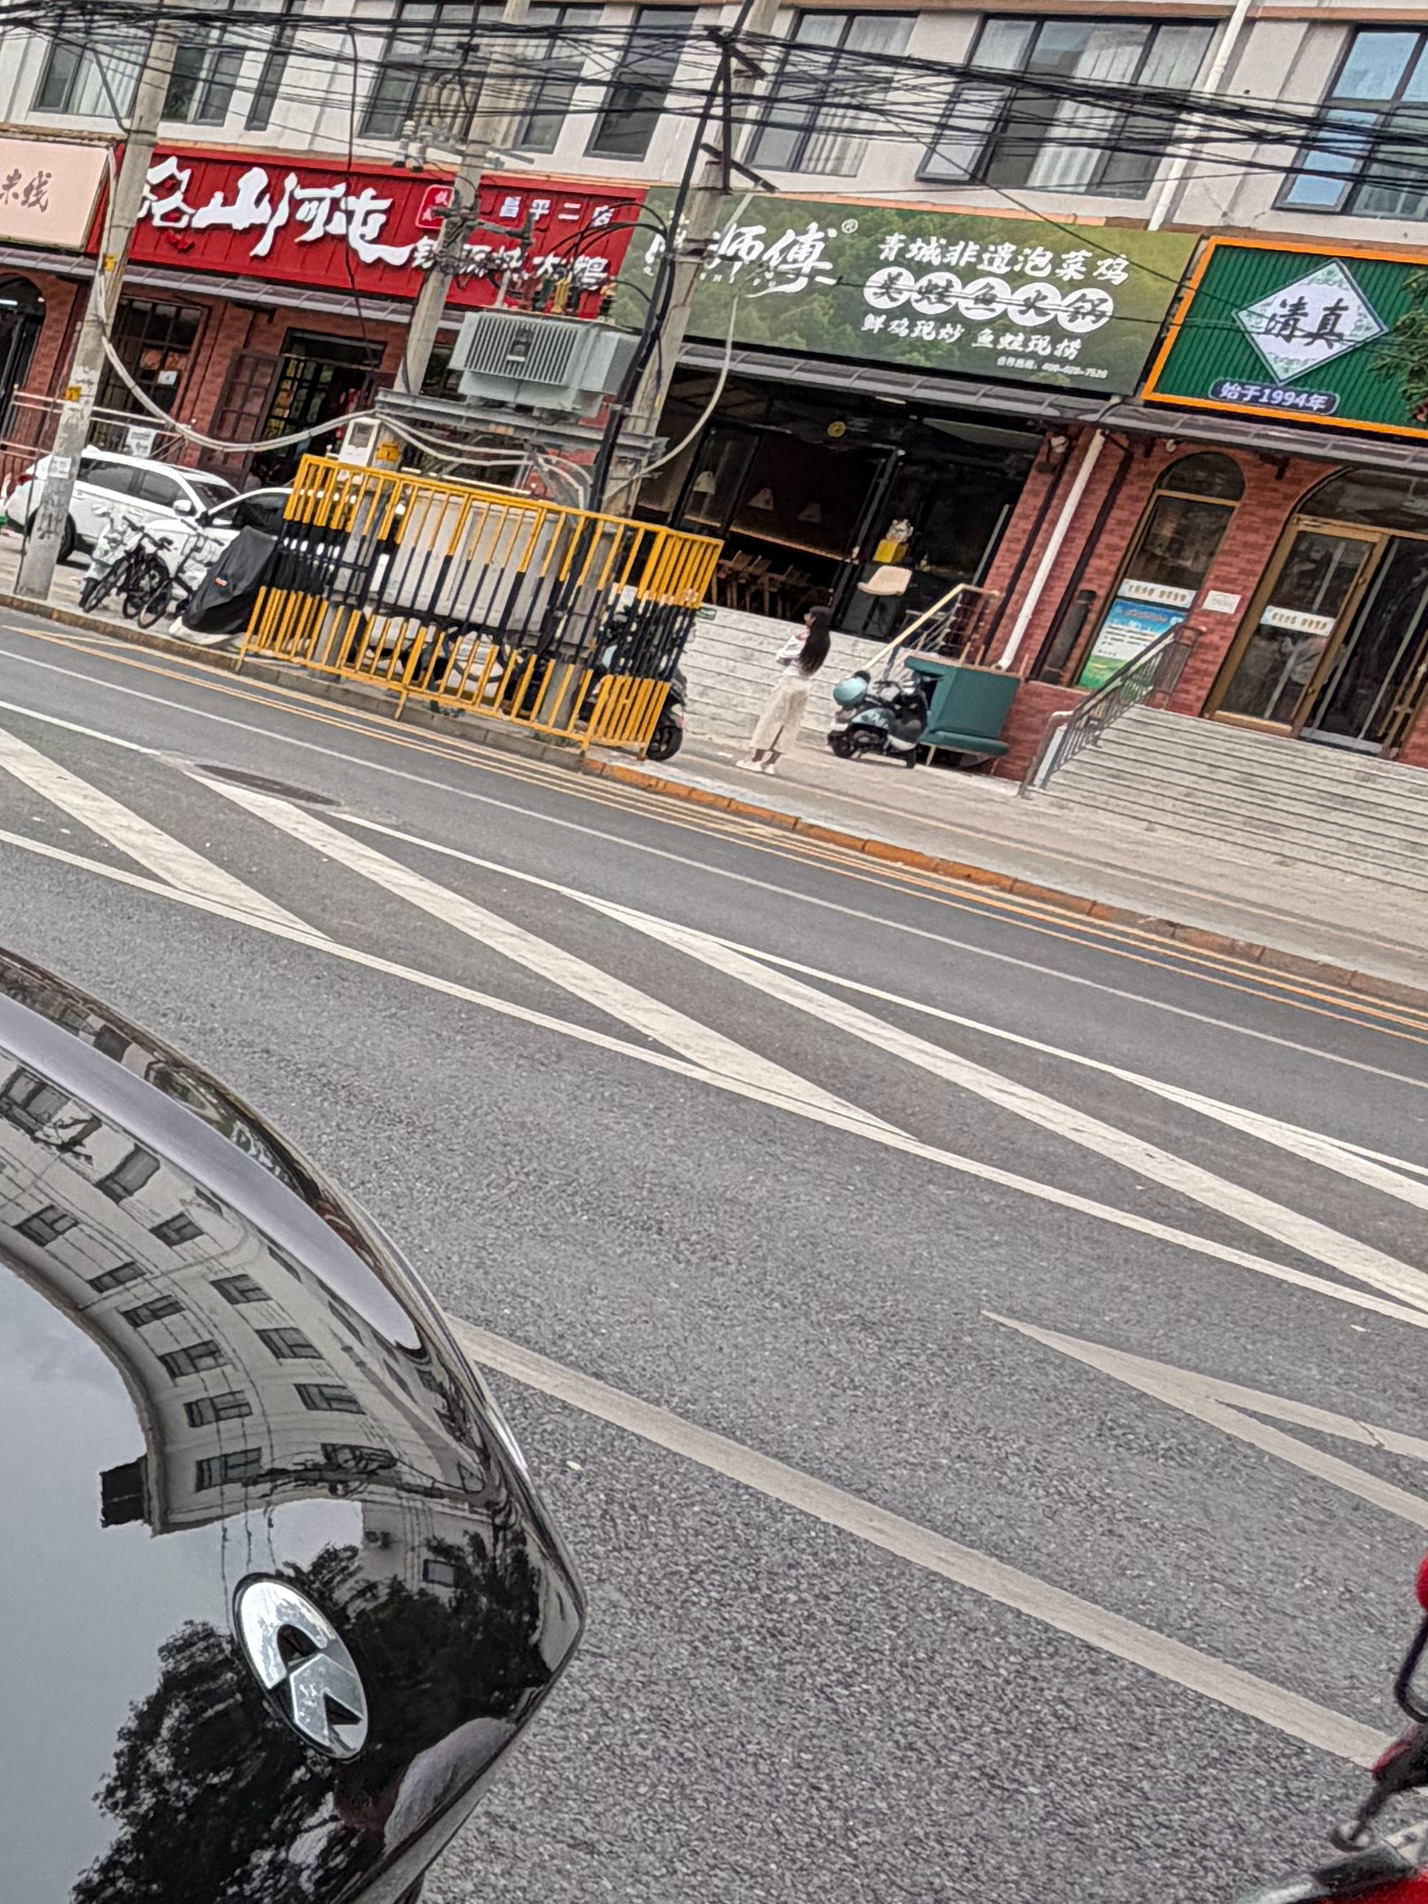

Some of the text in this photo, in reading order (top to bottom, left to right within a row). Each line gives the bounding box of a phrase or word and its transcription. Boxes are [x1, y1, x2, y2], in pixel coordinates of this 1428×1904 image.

[878, 232, 1130, 285] 青城非遗泡菜鸡
[1265, 295, 1349, 349] 清真
[1220, 380, 1328, 412] 始于1994年
